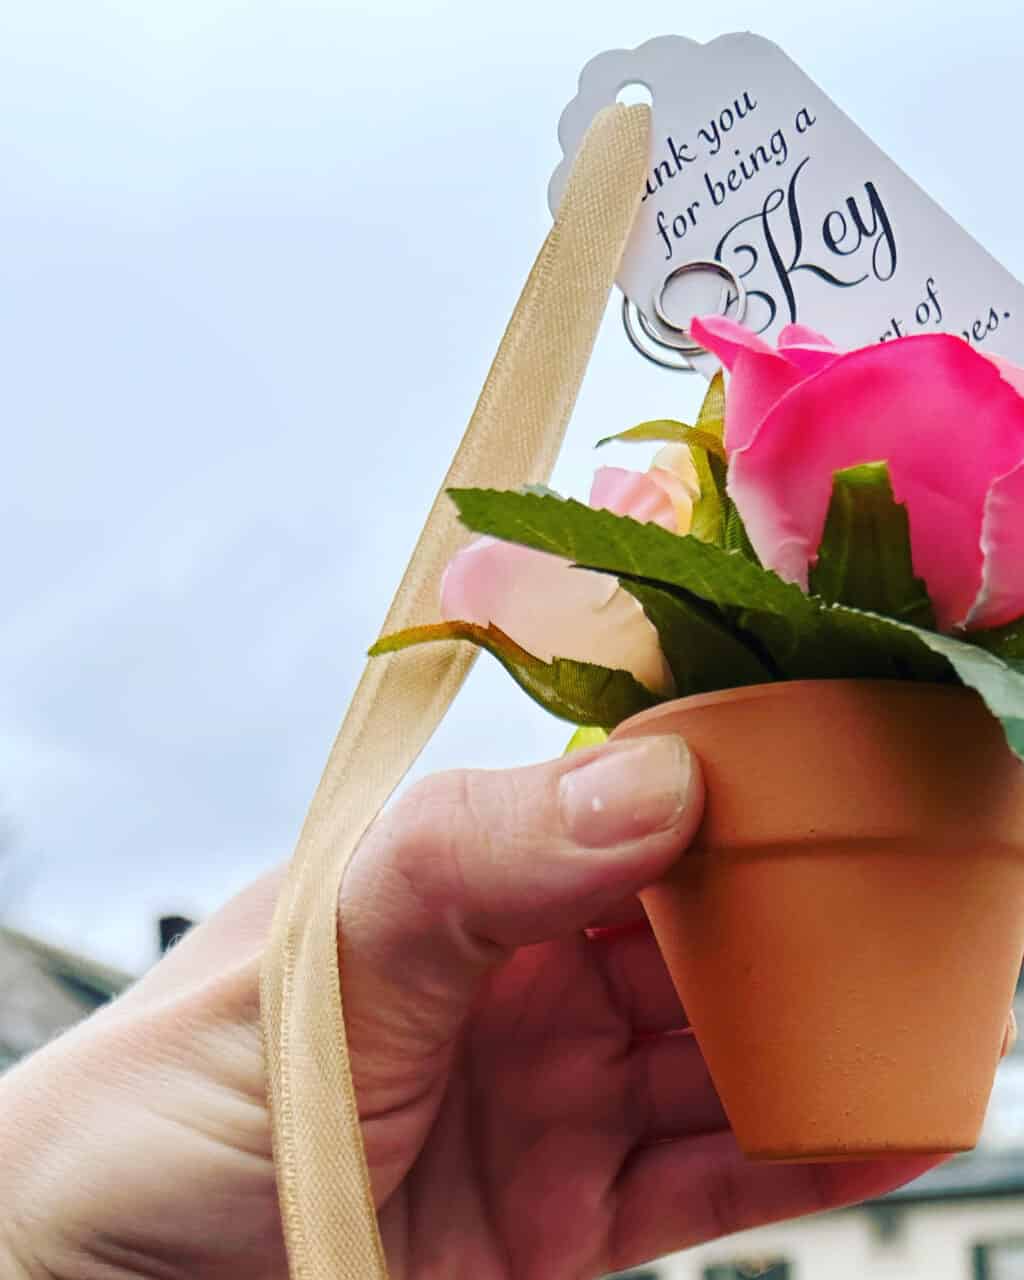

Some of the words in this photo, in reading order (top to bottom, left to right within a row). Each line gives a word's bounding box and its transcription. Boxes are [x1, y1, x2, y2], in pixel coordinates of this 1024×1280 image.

[697, 91, 758, 155] you
[656, 201, 700, 260] for
[703, 129, 788, 206] being
[795, 107, 817, 133] a
[713, 156, 897, 334] Key
[915, 276, 943, 324] of
